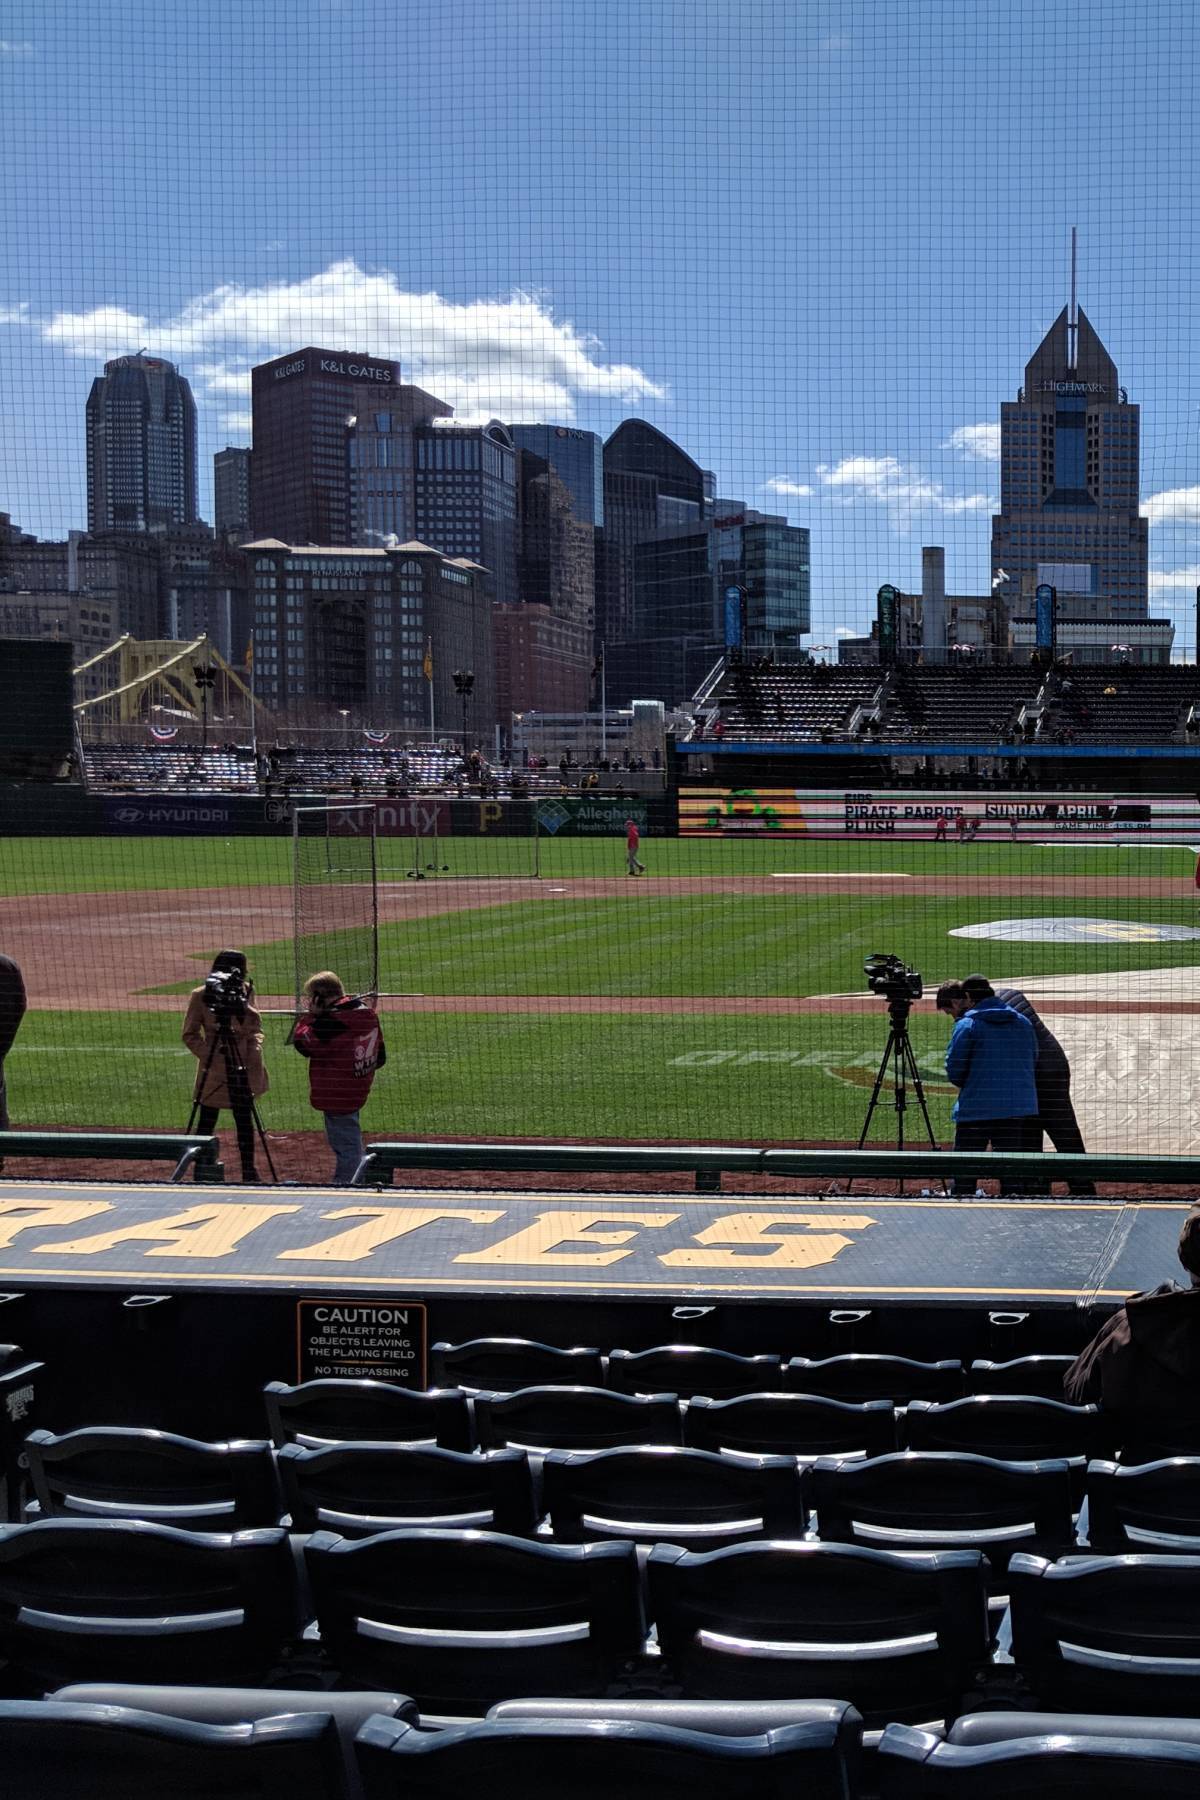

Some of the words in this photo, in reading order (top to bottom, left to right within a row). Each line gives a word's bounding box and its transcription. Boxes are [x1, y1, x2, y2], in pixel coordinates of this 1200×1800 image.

[286, 360, 305, 376] GATES
[321, 359, 346, 374] K&L
[350, 365, 392, 382] GATES
[1043, 380, 1105, 393] HIGHMARK
[568, 430, 585, 440] PNC
[150, 809, 228, 822] HYUNDAI
[577, 807, 647, 822] Allegheny
[845, 806, 897, 819] PIRATE
[1056, 804, 1102, 818] APRIL
[1109, 804, 1118, 818] 7
[577, 823, 606, 832] Health
[845, 820, 896, 833] PLUSH
[314, 1307, 409, 1324] CAUTION
[322, 1325, 337, 1334] BE
[340, 1326, 375, 1335] ALERT
[379, 1327, 400, 1336] FOR
[310, 1336, 361, 1346] OBJECTS
[363, 1338, 411, 1348] LEAVING
[308, 1347, 330, 1356] THE
[333, 1348, 380, 1358] PLAYING
[383, 1350, 415, 1359] FIELD
[314, 1366, 331, 1374] NO
[333, 1366, 409, 1377] TRESPASSING
